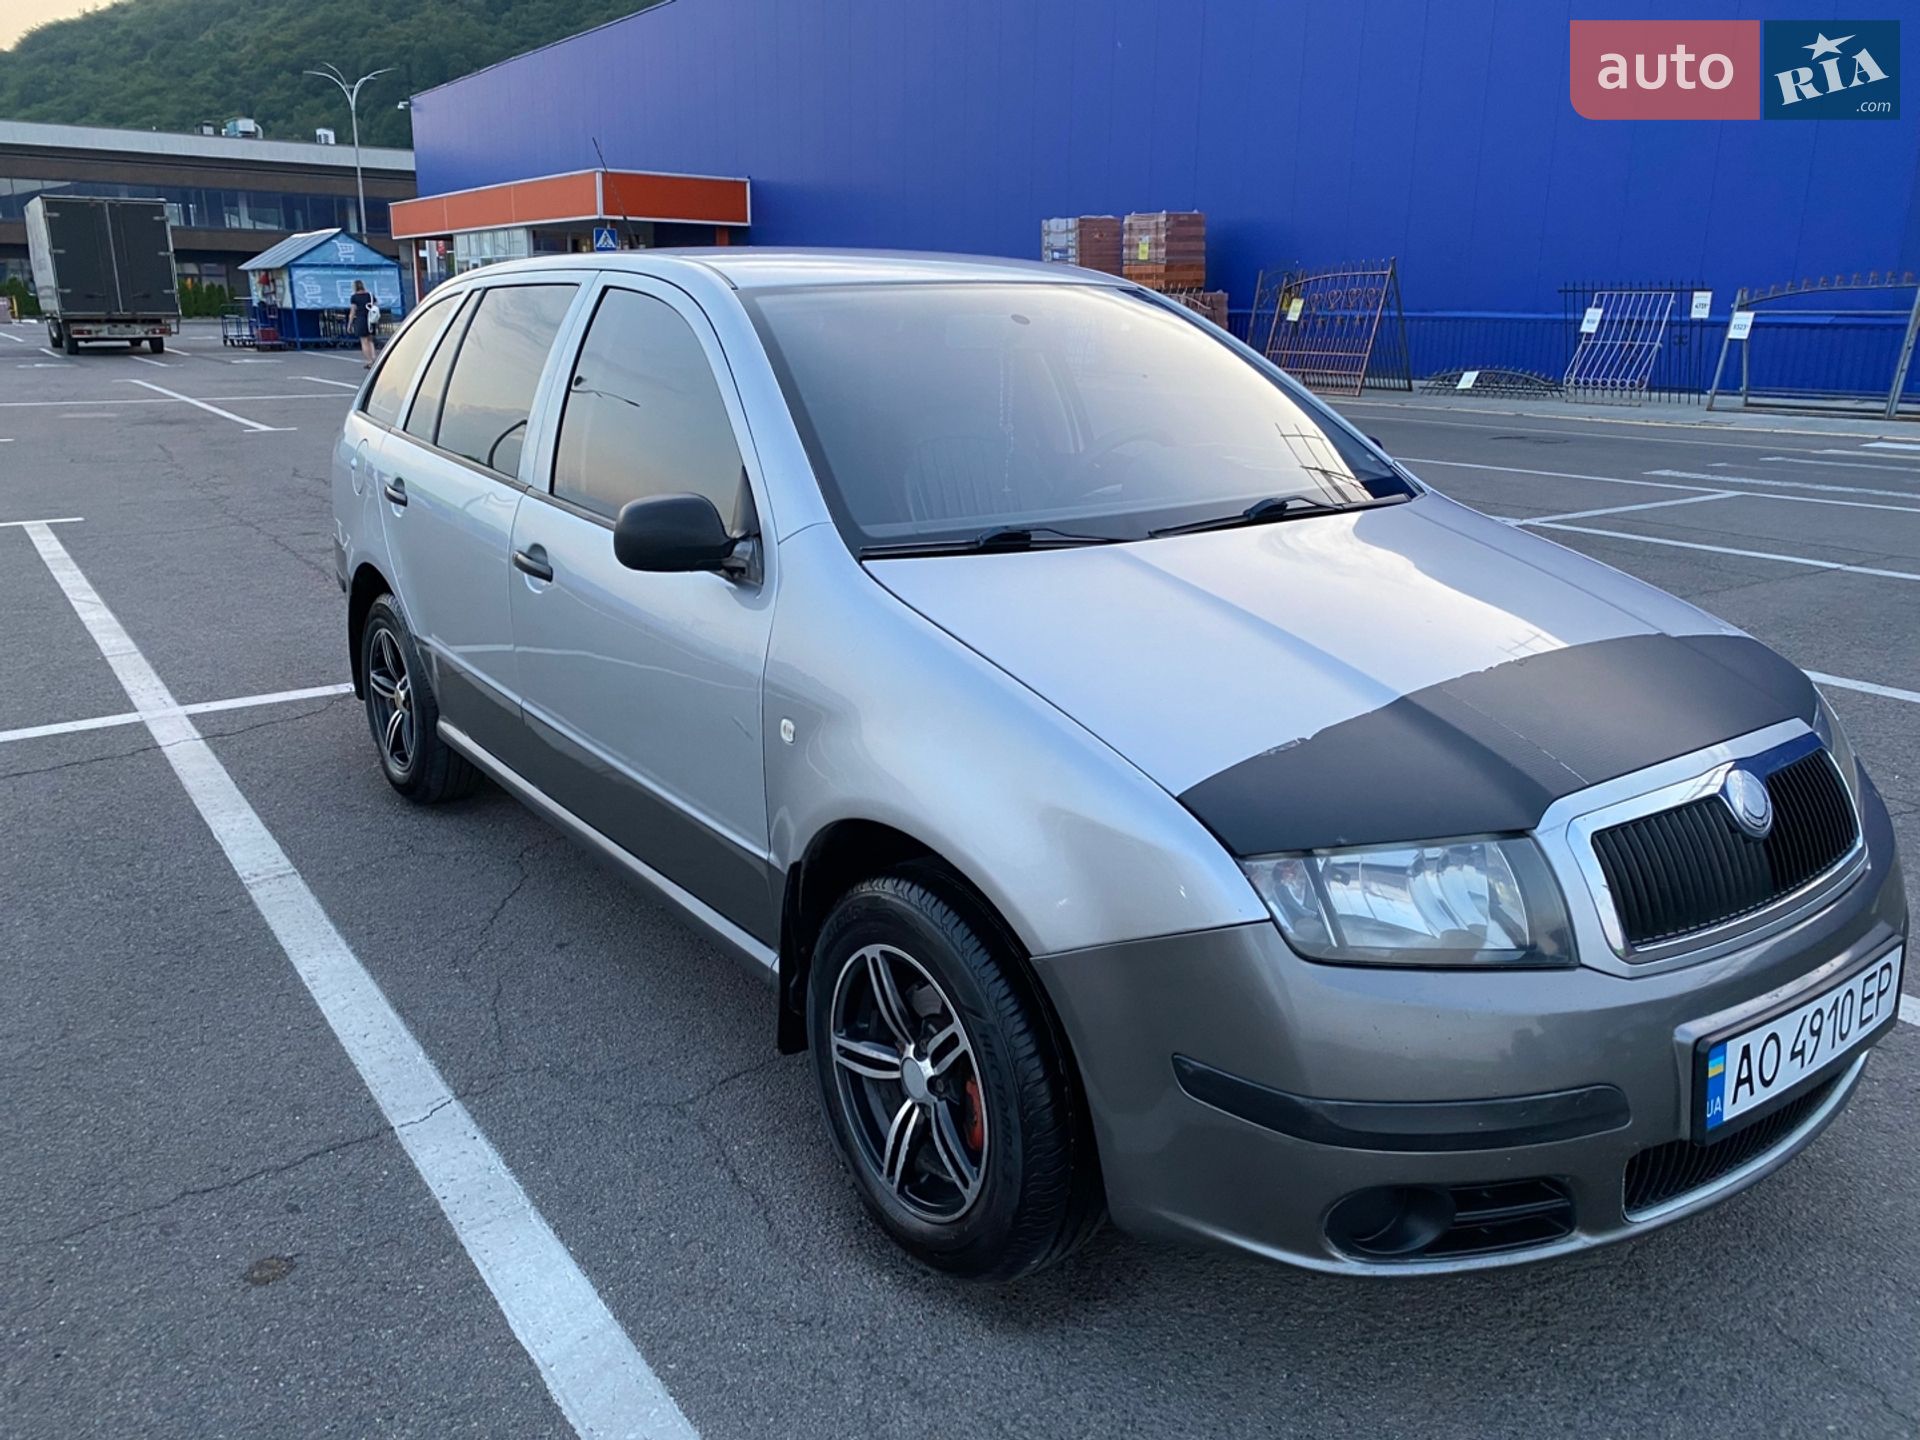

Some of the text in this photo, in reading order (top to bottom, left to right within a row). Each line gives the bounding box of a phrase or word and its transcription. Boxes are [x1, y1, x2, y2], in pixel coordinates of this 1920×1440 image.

[1731, 961, 1893, 1106] AO 4910 EP
[1706, 1095, 1722, 1118] UA
